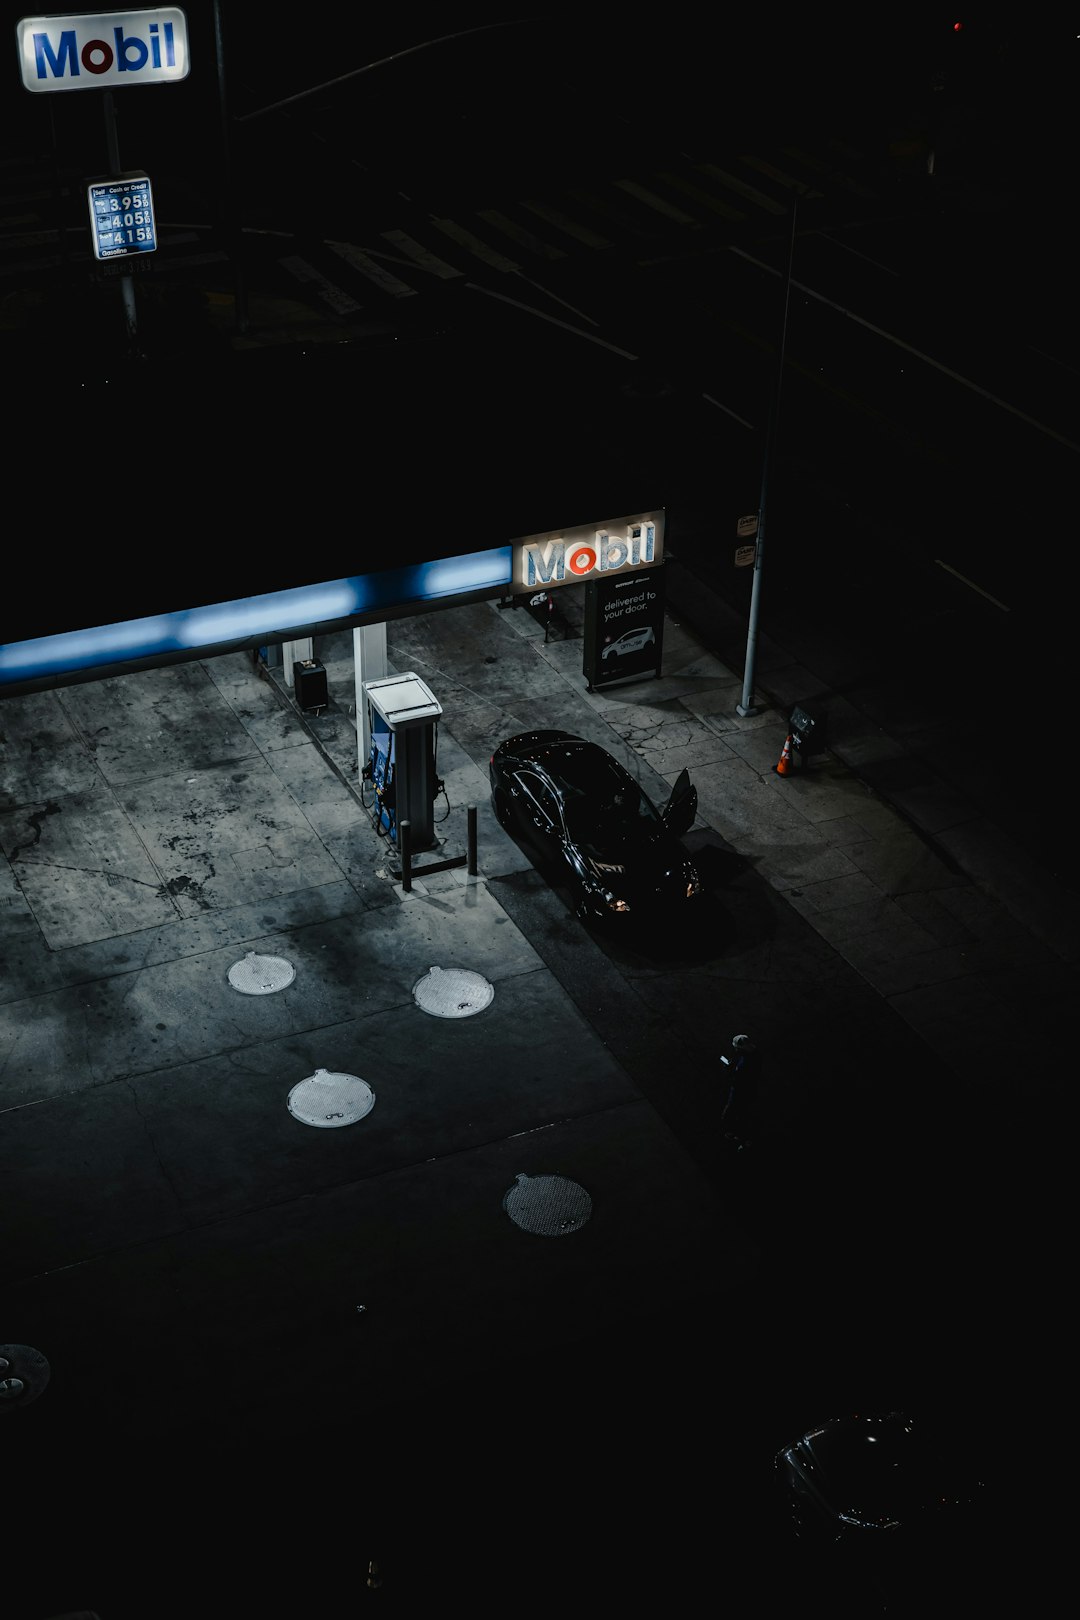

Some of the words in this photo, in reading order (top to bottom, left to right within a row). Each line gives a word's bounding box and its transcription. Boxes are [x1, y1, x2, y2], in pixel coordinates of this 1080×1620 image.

[32, 22, 176, 79] Mobil
[130, 183, 147, 191] Credit
[110, 194, 142, 211] 3.95
[112, 211, 144, 227] 4.05
[114, 227, 146, 244] 4.15
[101, 248, 128, 257] Gasoline
[522, 520, 656, 587] Mobil
[604, 592, 645, 612] delivered
[646, 591, 656, 600] to
[604, 608, 624, 622] your
[625, 603, 648, 614] door.
[620, 639, 643, 650] amuse
